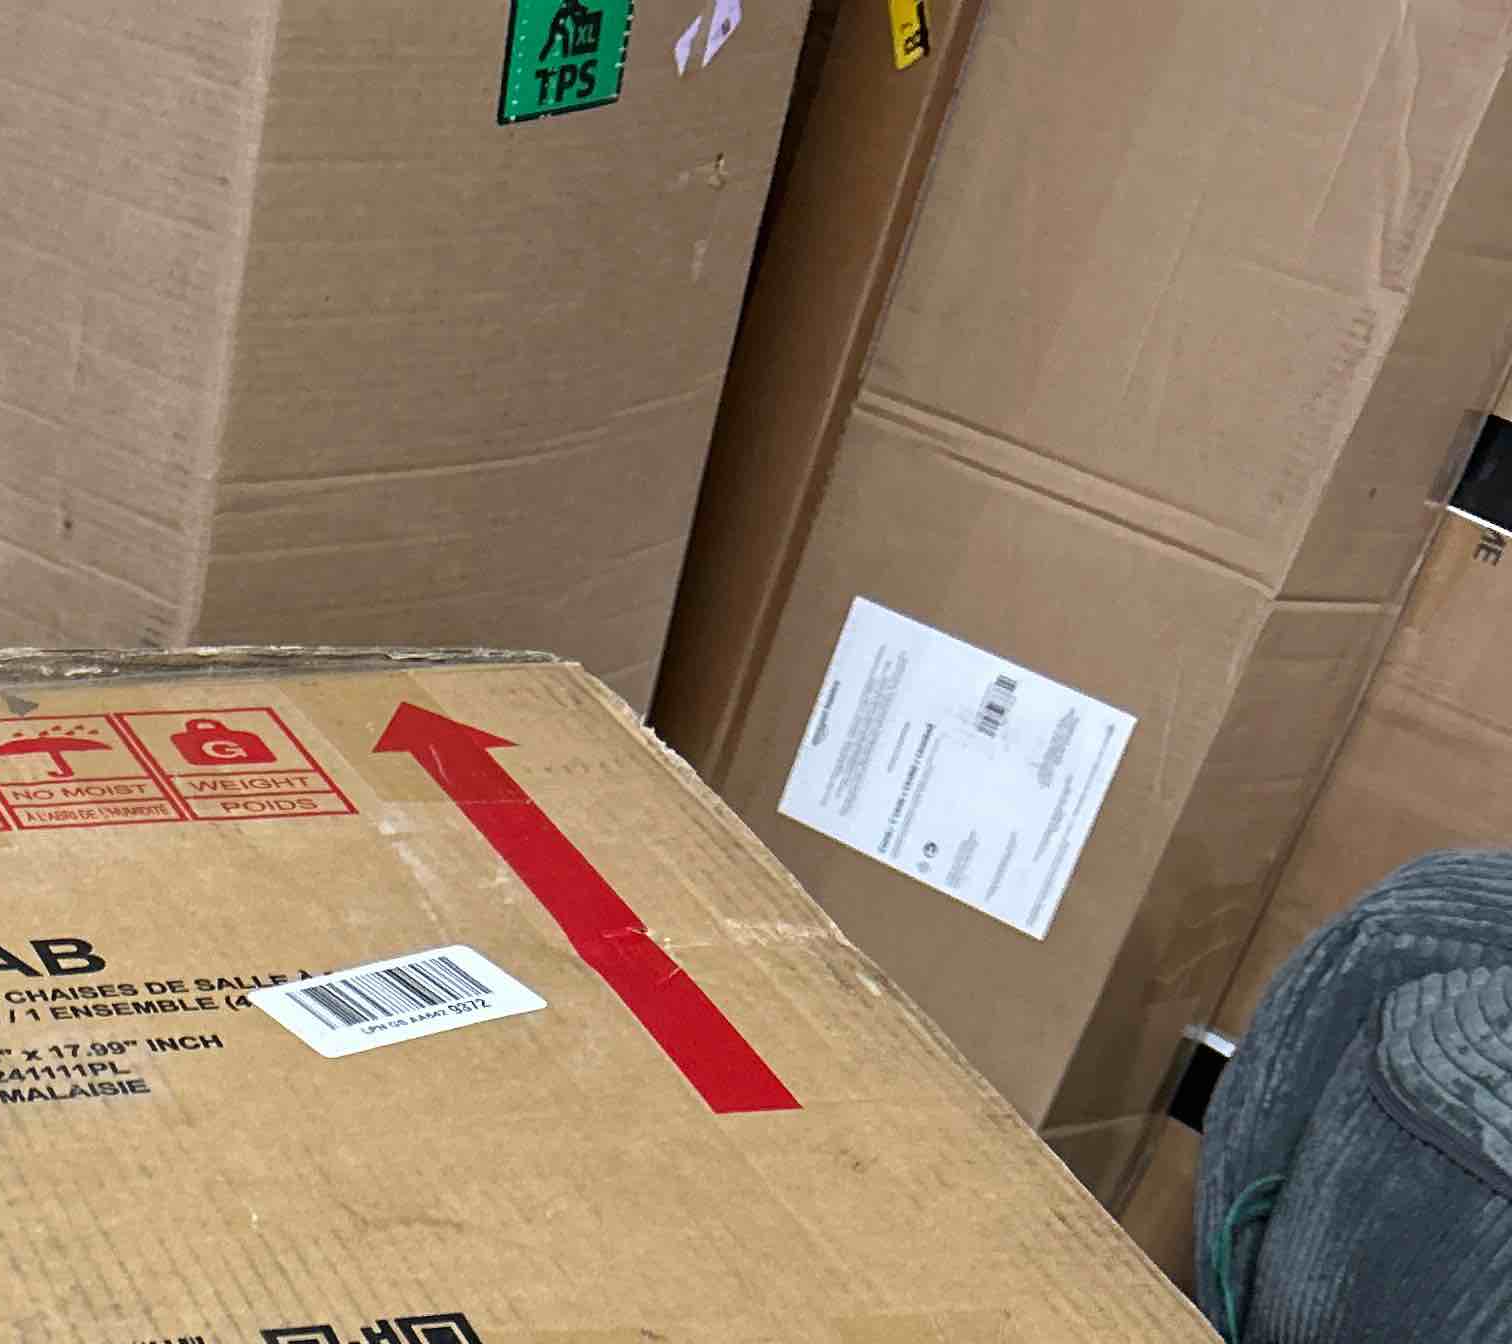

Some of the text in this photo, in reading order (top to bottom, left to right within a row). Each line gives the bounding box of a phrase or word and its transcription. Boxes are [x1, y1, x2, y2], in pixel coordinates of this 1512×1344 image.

[536, 59, 597, 106] TPS
[12, 783, 149, 801] NO MOIST
[188, 776, 309, 792] WEIGHT
[220, 798, 318, 813] POIDS
[4, 984, 137, 1005] CHAISES
[144, 979, 188, 995] DE
[194, 971, 290, 992] SALLE
[26, 1007, 41, 1022] 1
[50, 997, 219, 1021] ENSEMBLE
[146, 1034, 224, 1052] INCH
